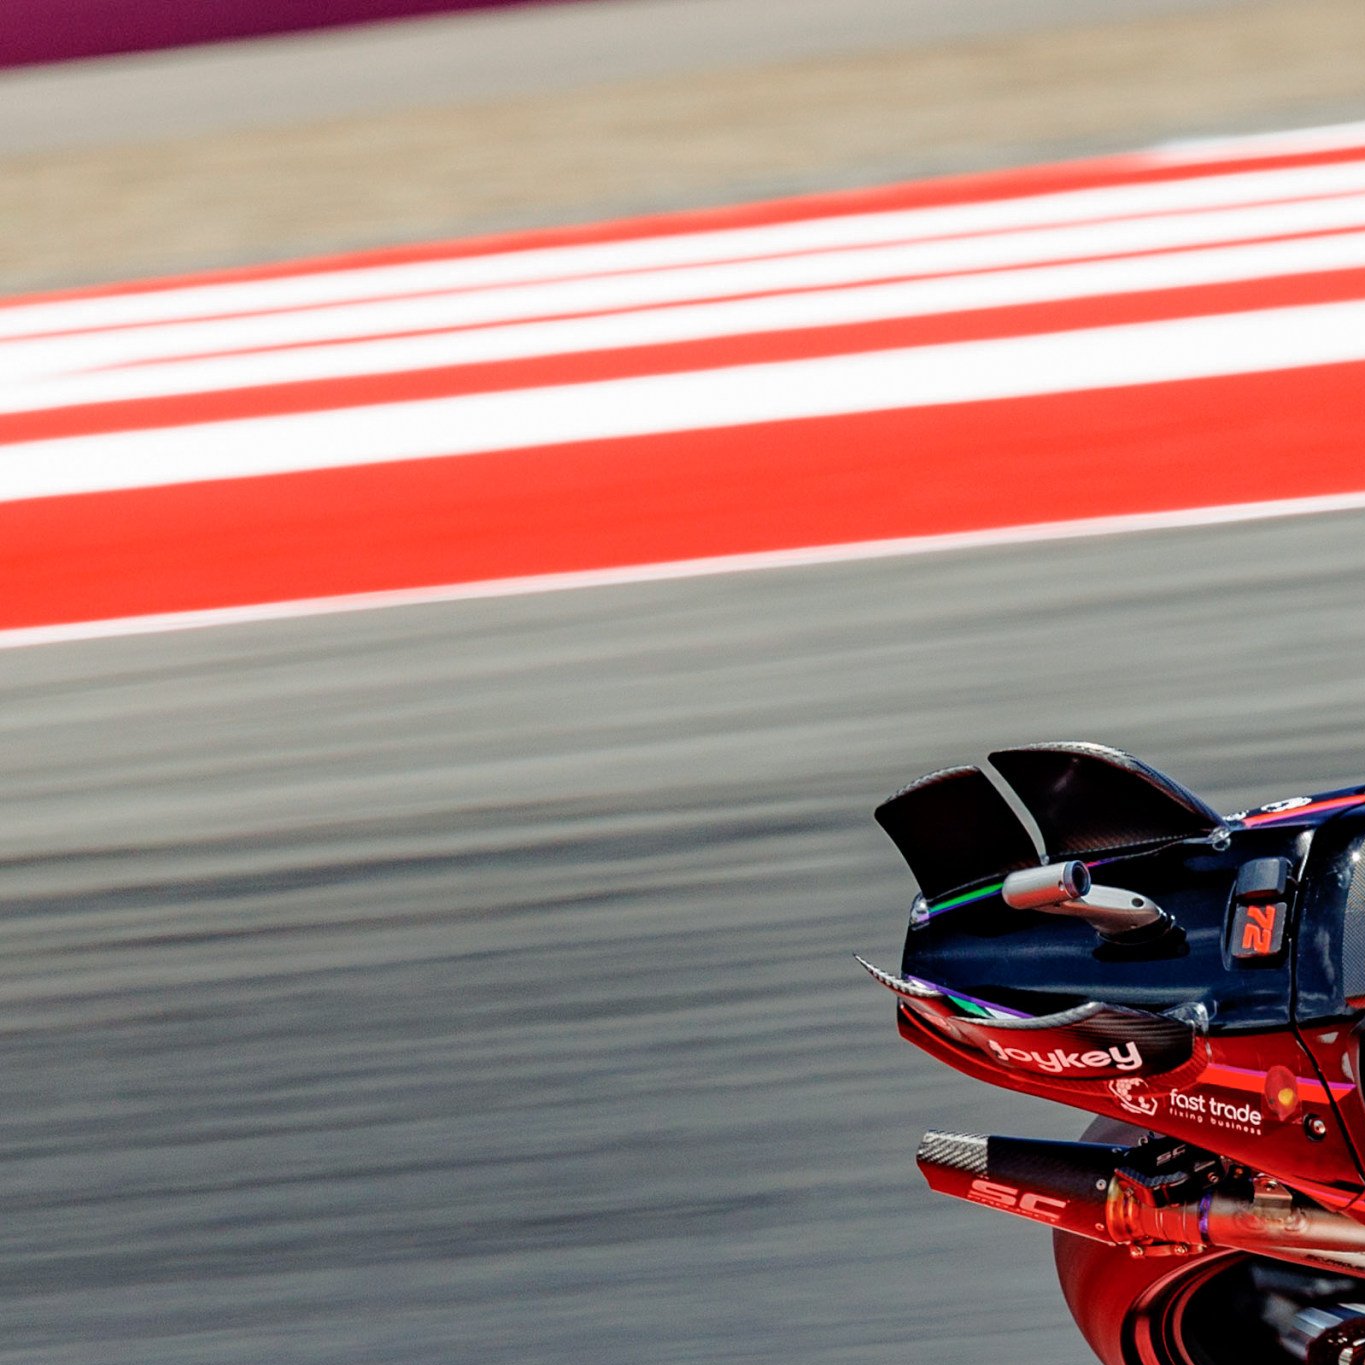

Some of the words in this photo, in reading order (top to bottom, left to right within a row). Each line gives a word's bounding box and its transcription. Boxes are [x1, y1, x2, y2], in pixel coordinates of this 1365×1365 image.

[1241, 903, 1277, 955] 72
[1169, 1089, 1206, 1113] fast
[1209, 1097, 1262, 1126] trade
[1169, 1107, 1204, 1124] fixing
[1210, 1117, 1263, 1136] business
